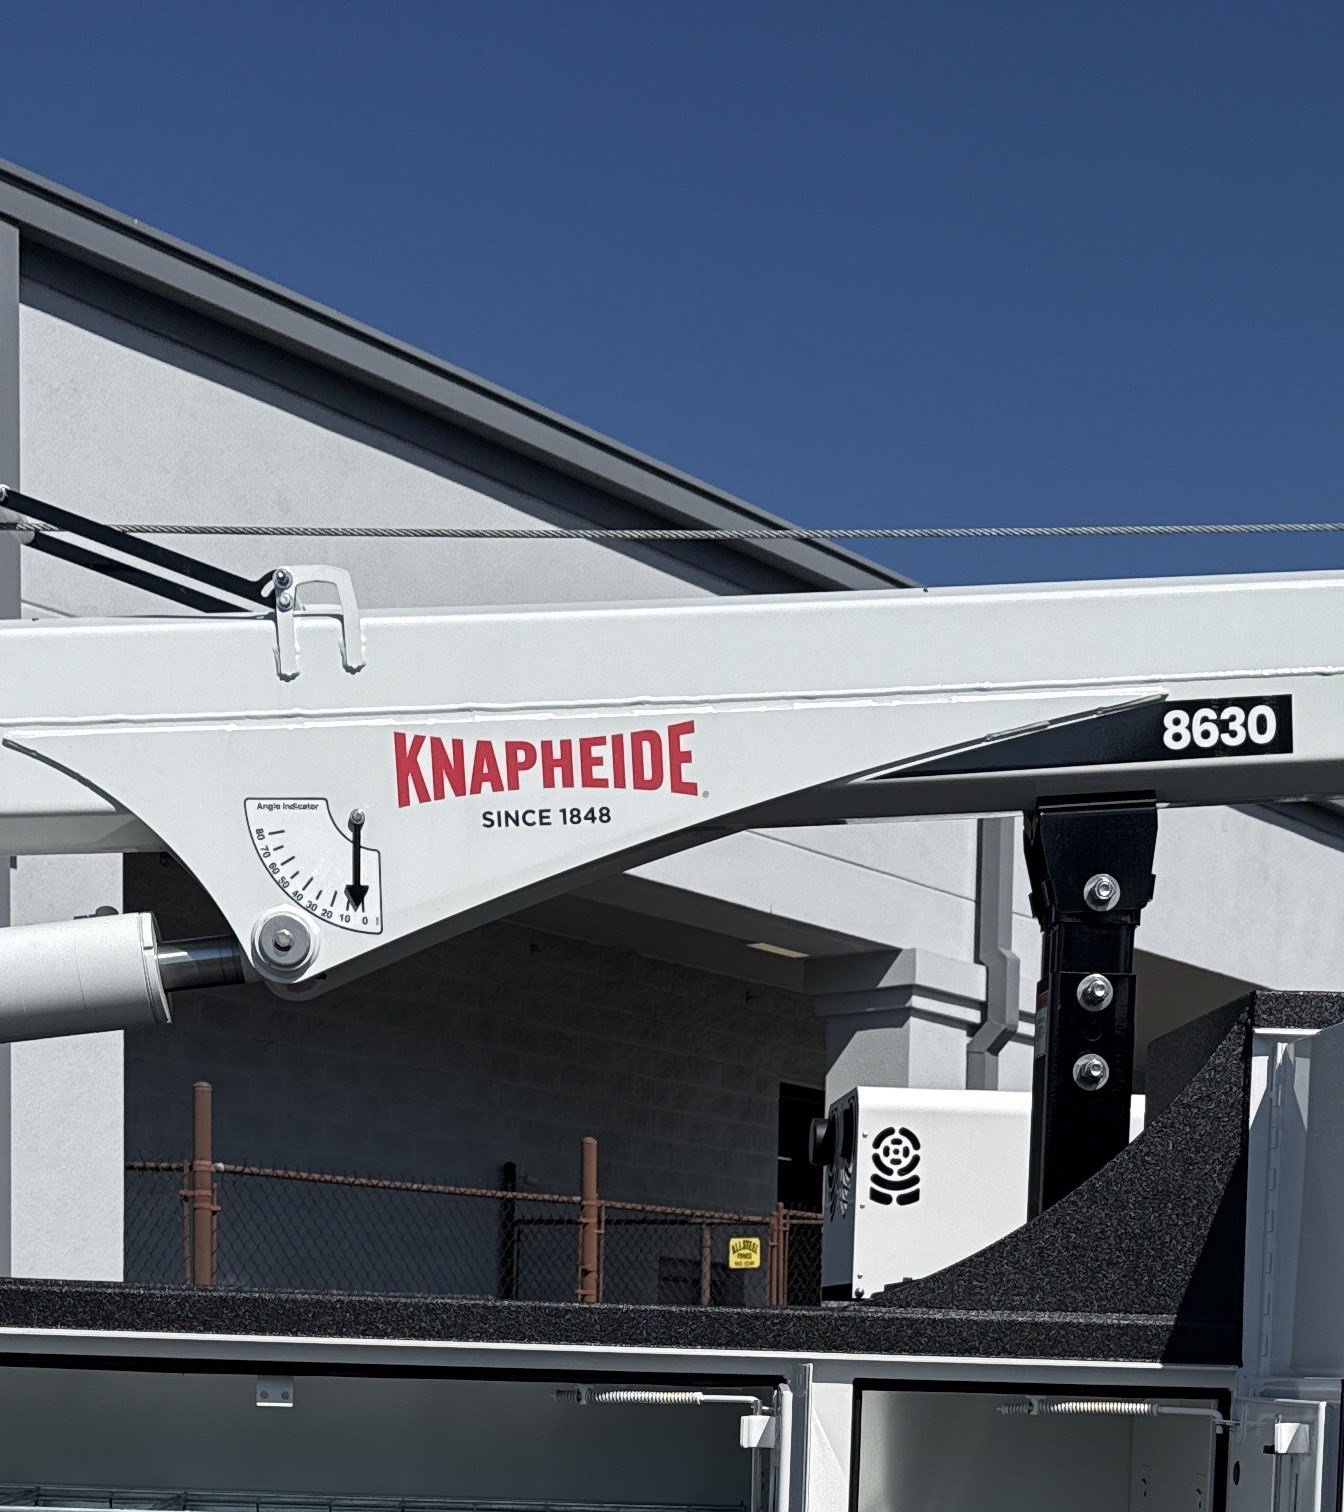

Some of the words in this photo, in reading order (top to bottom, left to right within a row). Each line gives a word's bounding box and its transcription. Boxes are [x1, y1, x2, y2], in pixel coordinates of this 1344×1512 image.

[1162, 704, 1277, 750] 8630
[393, 719, 699, 809] KNAPHEIDE
[282, 802, 320, 811] Indicator
[481, 808, 552, 828] SINCE
[558, 806, 612, 826] 1848
[255, 828, 265, 841] 80
[259, 845, 271, 858] 70
[268, 862, 280, 875] 60
[278, 877, 290, 889] 50
[291, 890, 304, 901] 40
[306, 900, 318, 912] 30
[321, 908, 333, 919] 20
[339, 913, 351, 923] 10
[362, 916, 369, 925] 0
